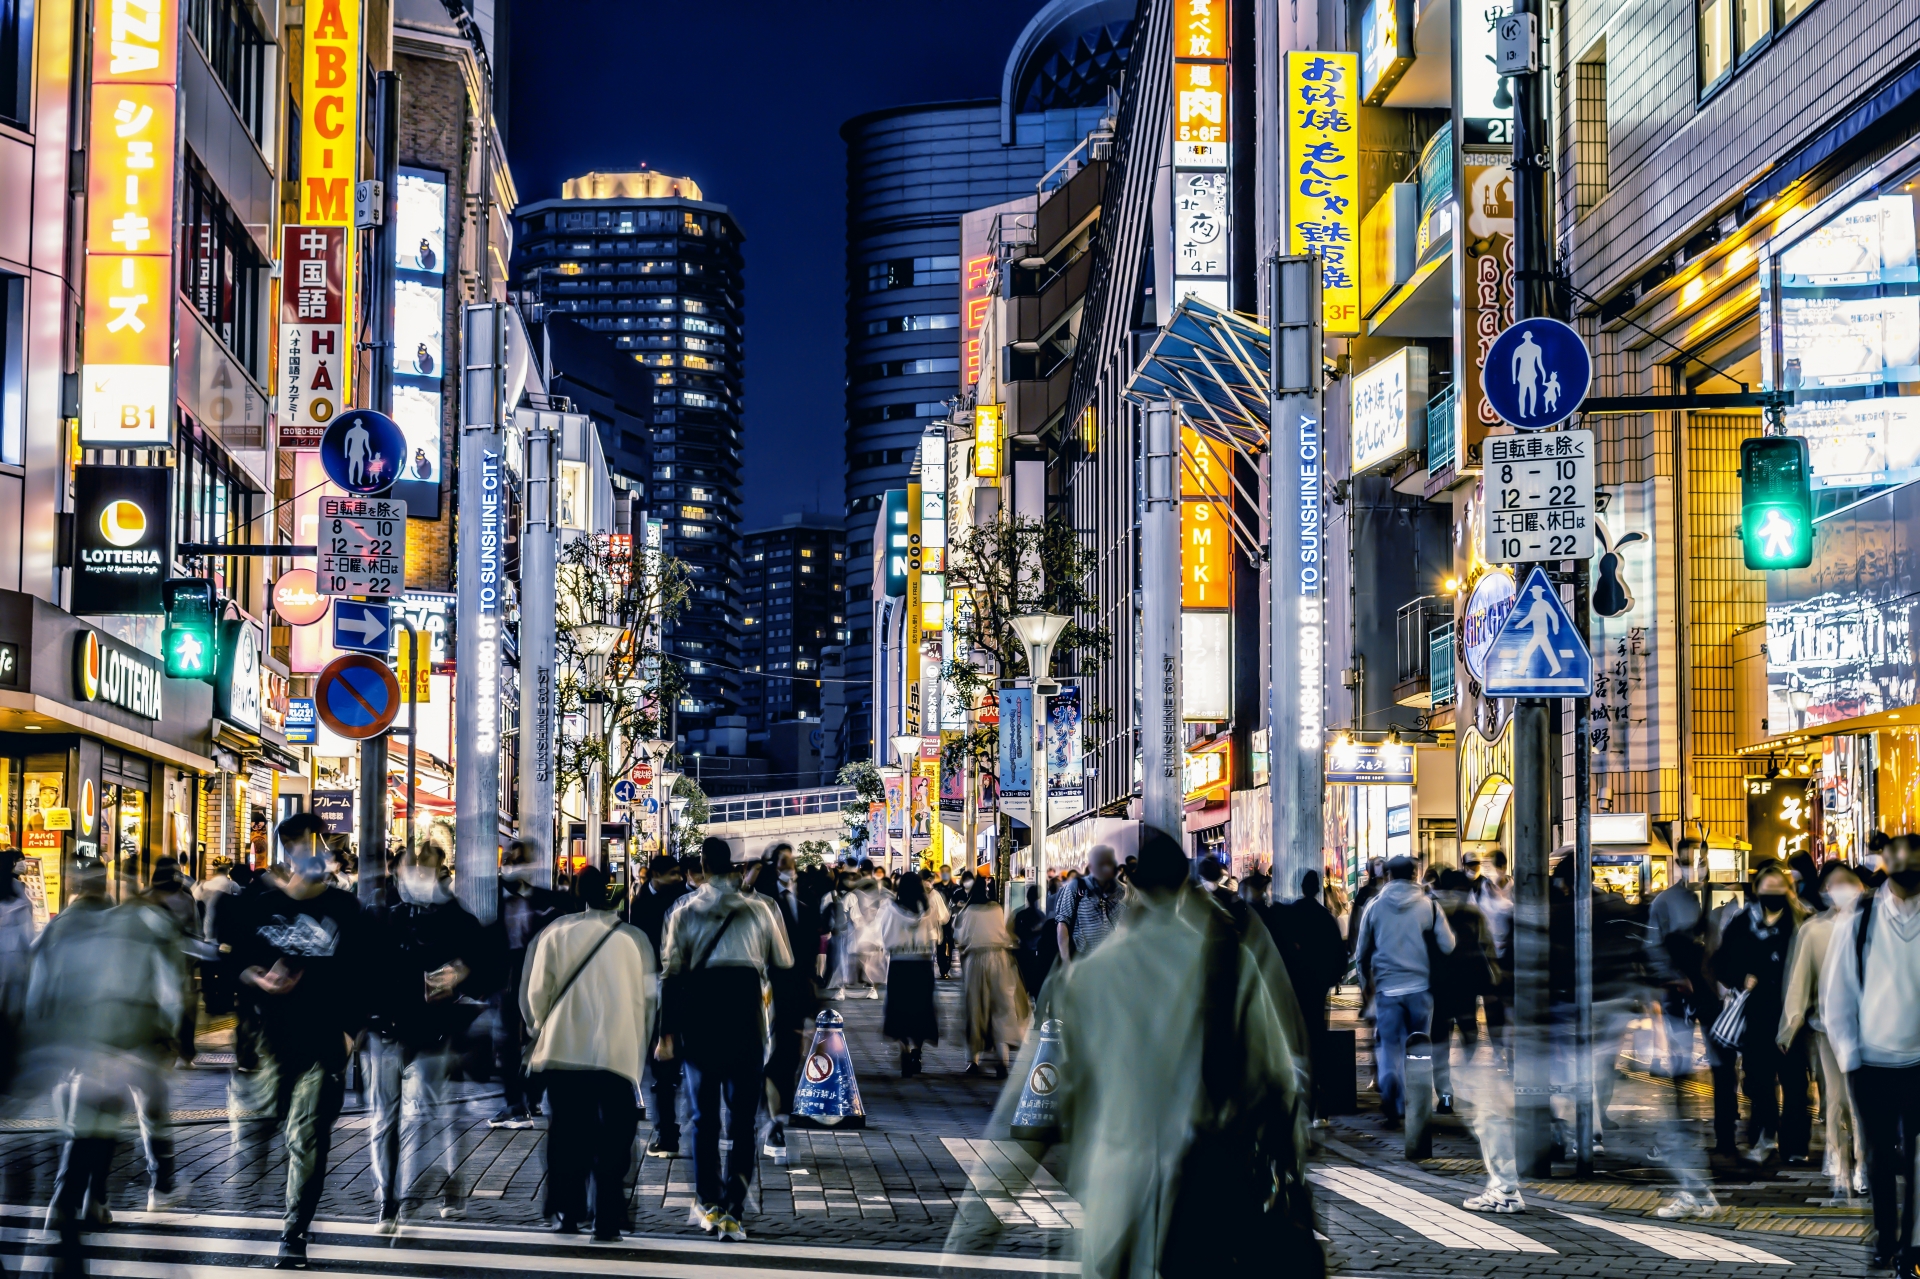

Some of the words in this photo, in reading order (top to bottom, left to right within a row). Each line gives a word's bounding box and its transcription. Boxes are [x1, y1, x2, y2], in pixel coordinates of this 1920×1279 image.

[1179, 88, 1222, 123] 肉
[106, 99, 154, 334] シェーキーズ
[298, 228, 328, 319] 中国語
[1329, 304, 1356, 320] 3F
[288, 329, 301, 422] ハオ中国語アカデミー
[119, 404, 156, 430] B1
[1300, 415, 1318, 461] CITY
[1492, 436, 1585, 460] 自転車を除く
[482, 449, 499, 491] CITY
[1501, 464, 1513, 483] 8
[1556, 460, 1576, 481] 10
[325, 500, 400, 517] 自転車を除く
[1501, 488, 1521, 509] 12
[1549, 485, 1576, 506] 22
[1300, 464, 1318, 564] SUNSHINE
[1492, 510, 1586, 534] 土・日曜、休日は
[332, 519, 342, 534] 8
[377, 521, 392, 537] 10
[481, 494, 498, 584] SUNSHINE
[82, 549, 161, 564] LOTTERIA
[331, 538, 348, 554] 12
[370, 540, 392, 555] 22
[1501, 538, 1521, 558] 10
[1549, 536, 1577, 556] 22
[323, 558, 399, 574] 土・日曜、休日は
[330, 576, 346, 592] 10
[369, 578, 391, 593] 22
[1300, 567, 1318, 595] TO
[480, 587, 497, 612] TO
[1300, 597, 1319, 624] ST
[478, 614, 497, 640] ST
[1631, 628, 1642, 655] 2F
[0, 648, 13, 677] fe
[536, 665, 549, 683] ST
[1163, 653, 1176, 672] ST
[100, 644, 163, 722] LOTTERIA
[400, 669, 429, 683] AC
[1163, 676, 1176, 694] 60
[400, 684, 429, 693] MRT
[536, 687, 548, 704] 60
[536, 707, 548, 782] SUNSHINE
[1163, 698, 1176, 777] SUNSHINE
[926, 747, 937, 756] 2F
[1750, 782, 1772, 794] 2F
[313, 796, 351, 808] ブルーム
[28, 832, 55, 840] アルバイト
[1778, 796, 1809, 860] そば
